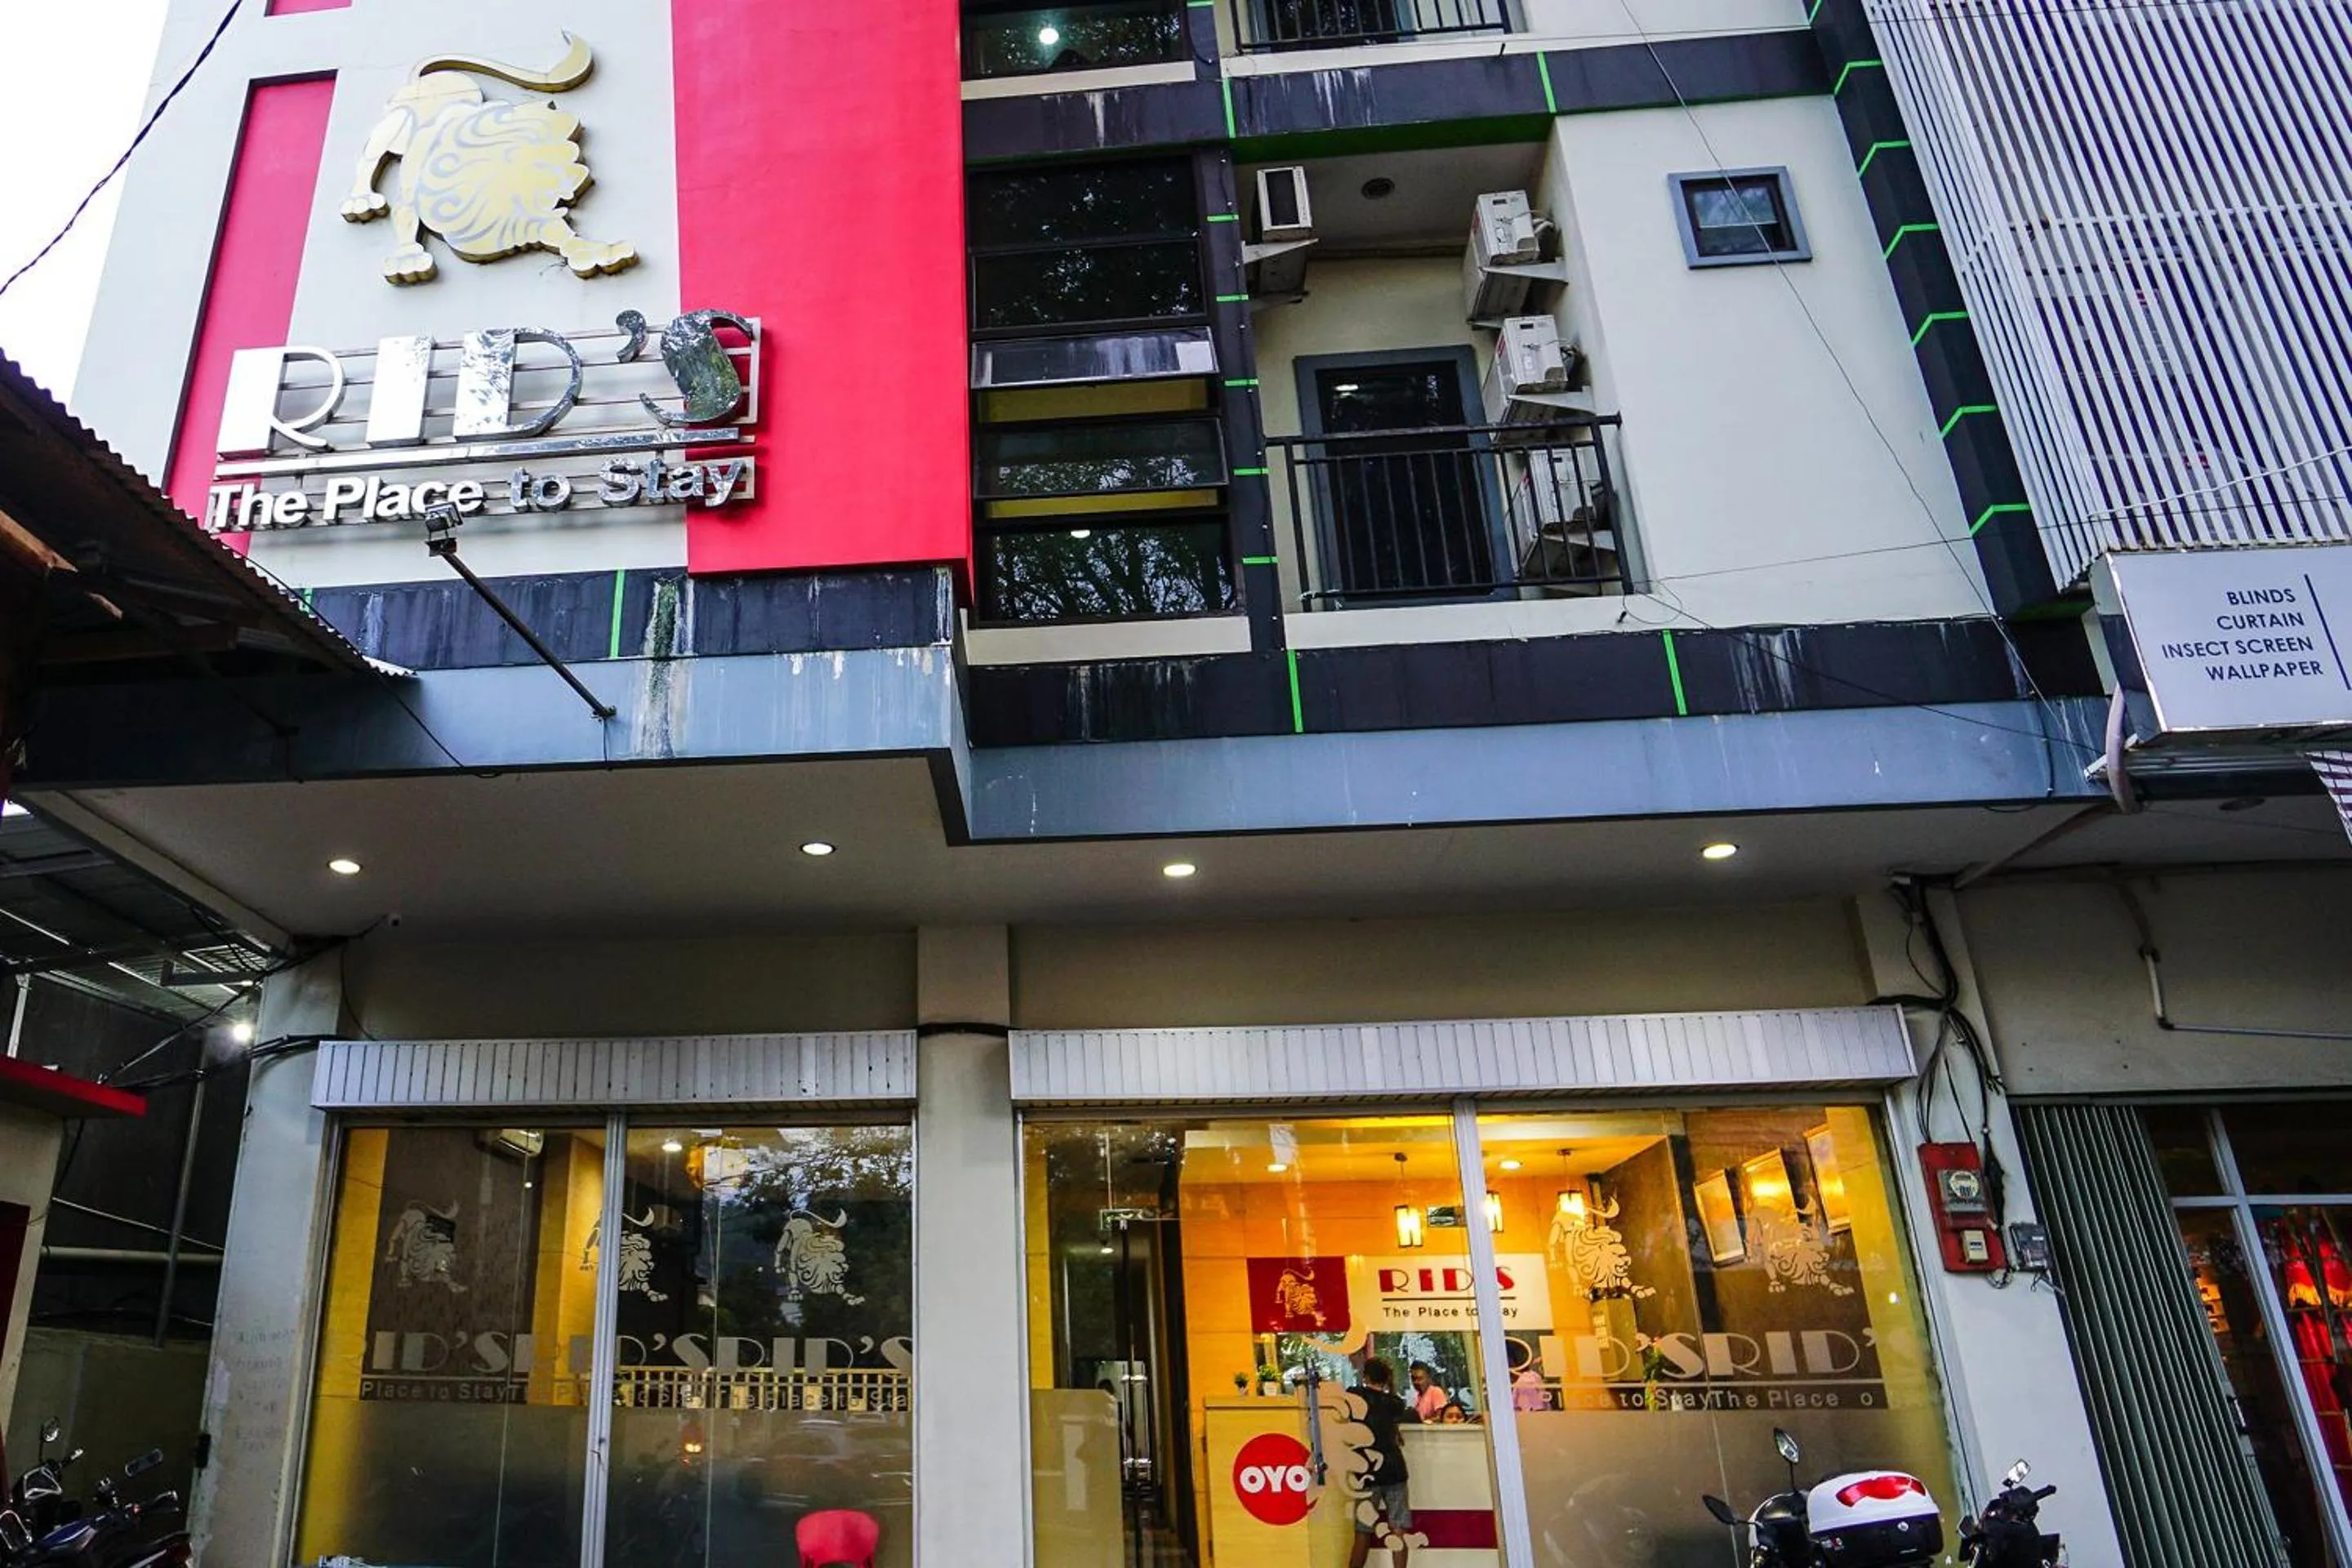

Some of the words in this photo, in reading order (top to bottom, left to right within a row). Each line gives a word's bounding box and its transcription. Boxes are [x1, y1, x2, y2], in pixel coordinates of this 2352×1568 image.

[216, 309, 756, 457] RID'S
[210, 483, 308, 532] The
[323, 475, 484, 523] Place
[509, 466, 571, 512] to
[599, 457, 746, 507] Stay
[2227, 589, 2296, 605] BLINDS
[2216, 612, 2305, 630] CURTAIN
[2163, 641, 2229, 658] INSECT
[2236, 637, 2314, 655] SCREEN
[2206, 661, 2323, 681] WALLPAPER
[1379, 1266, 1515, 1292] RIDS
[1383, 1307, 1410, 1317] The
[1419, 1306, 1459, 1317] Place
[362, 1380, 423, 1399] Place
[459, 1382, 506, 1402] Stay
[1619, 1391, 1643, 1407] to
[1711, 1390, 1758, 1408] The
[1768, 1390, 1838, 1408] Place
[1240, 1465, 1311, 1494] OYO
